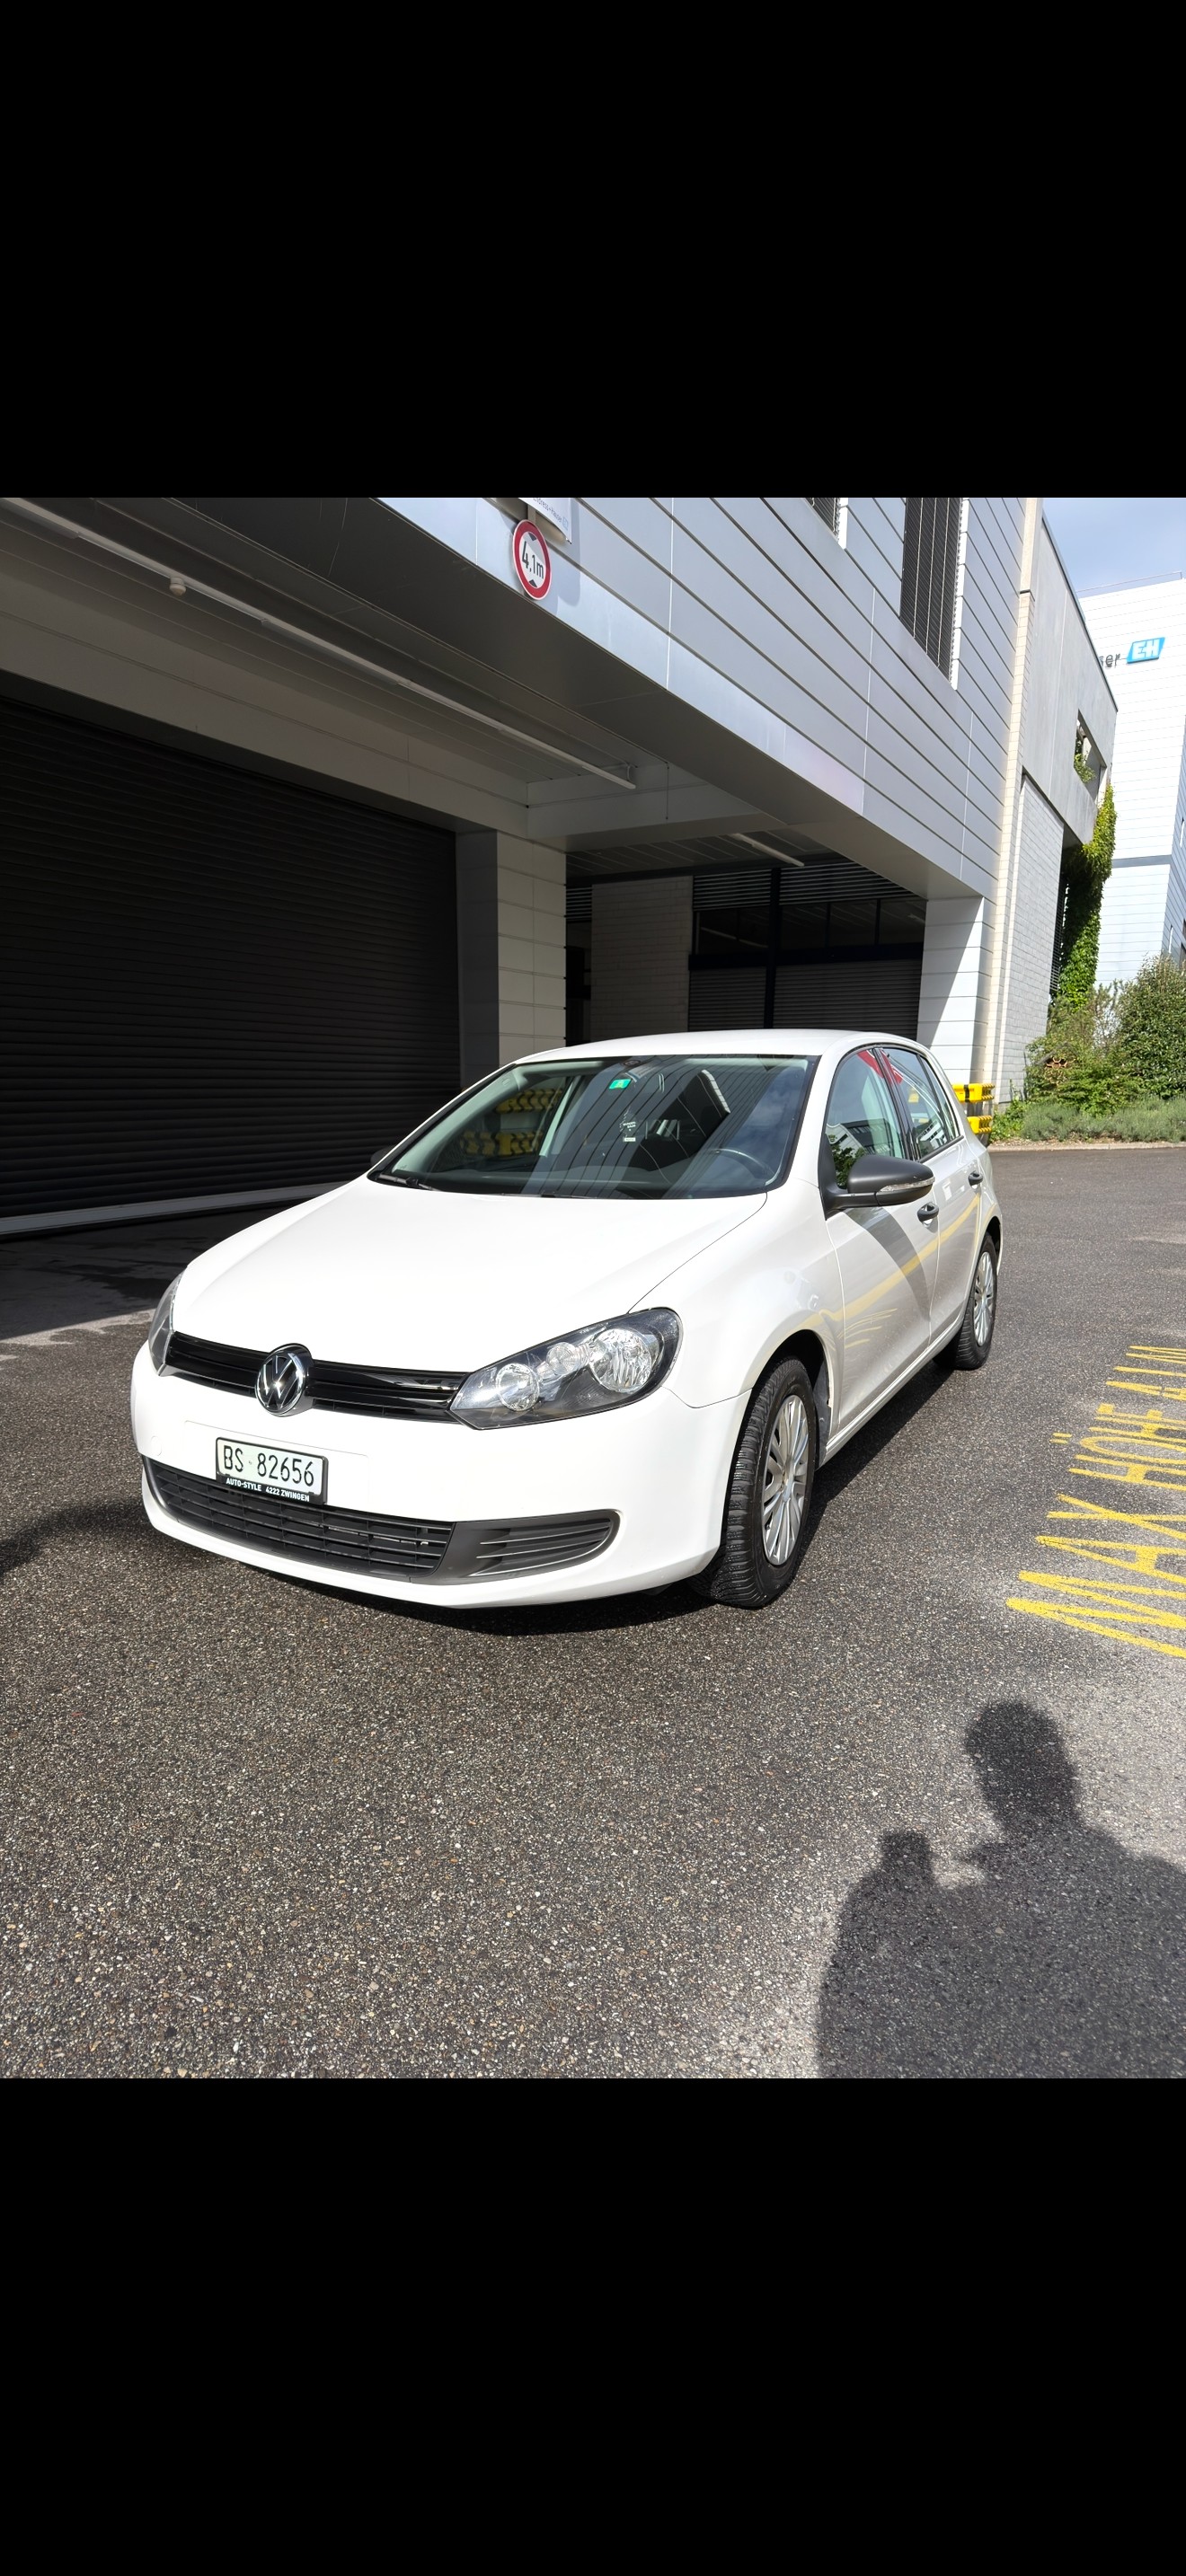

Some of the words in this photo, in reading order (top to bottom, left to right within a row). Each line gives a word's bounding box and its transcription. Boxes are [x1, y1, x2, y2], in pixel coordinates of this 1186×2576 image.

[522, 541, 544, 579] 4,1m
[223, 1444, 243, 1473] BS
[257, 1452, 314, 1486] 82656
[226, 1478, 262, 1492] AUTO-STYLE
[265, 1486, 280, 1495] 4222
[280, 1489, 310, 1502] ZWINGEN
[1005, 1492, 1186, 1659] MAX
